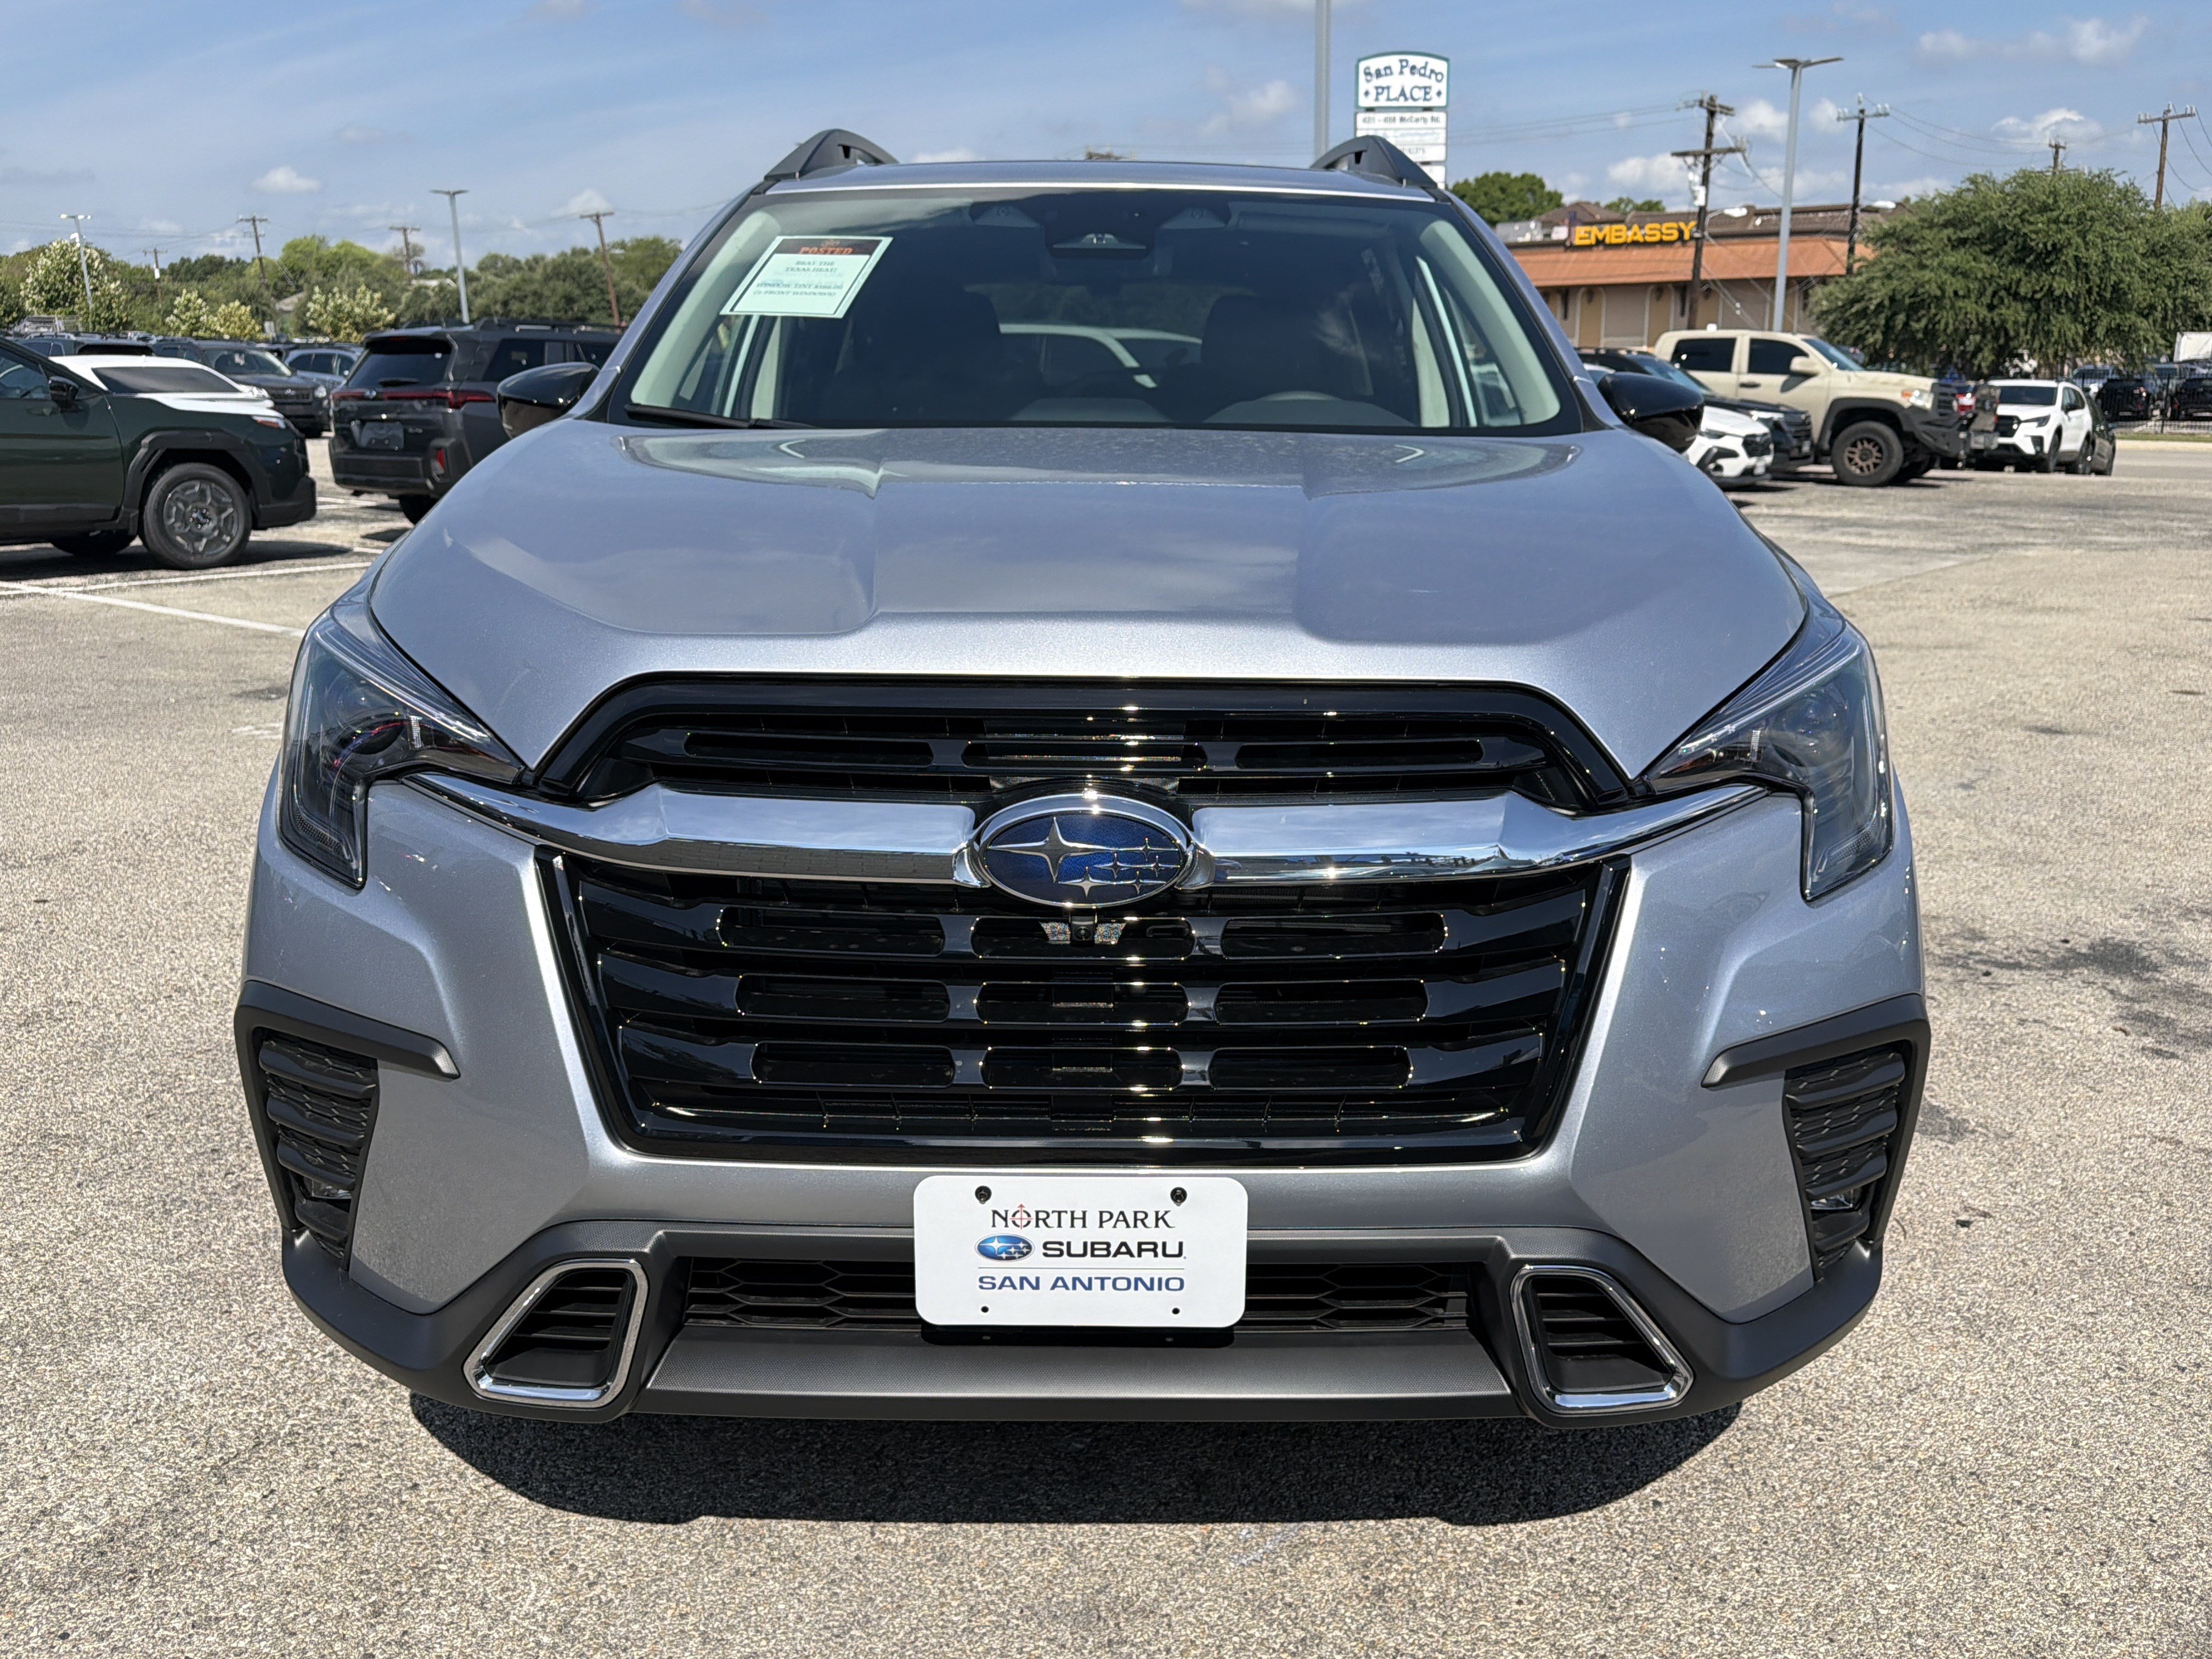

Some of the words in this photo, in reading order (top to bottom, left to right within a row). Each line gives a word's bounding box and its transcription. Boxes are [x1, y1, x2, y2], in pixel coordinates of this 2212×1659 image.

[1363, 65, 1393, 83] San
[1398, 59, 1444, 83] Pedro
[1374, 85, 1432, 102] PLACE
[1573, 221, 1697, 246] EMBASSY
[799, 247, 854, 255] POSTED
[991, 1209, 1088, 1229] NORTH
[1098, 1210, 1176, 1229] PARK
[1042, 1240, 1184, 1258] SUBARU
[978, 1276, 1041, 1291] SAN
[1049, 1276, 1185, 1292] ANTONIO
